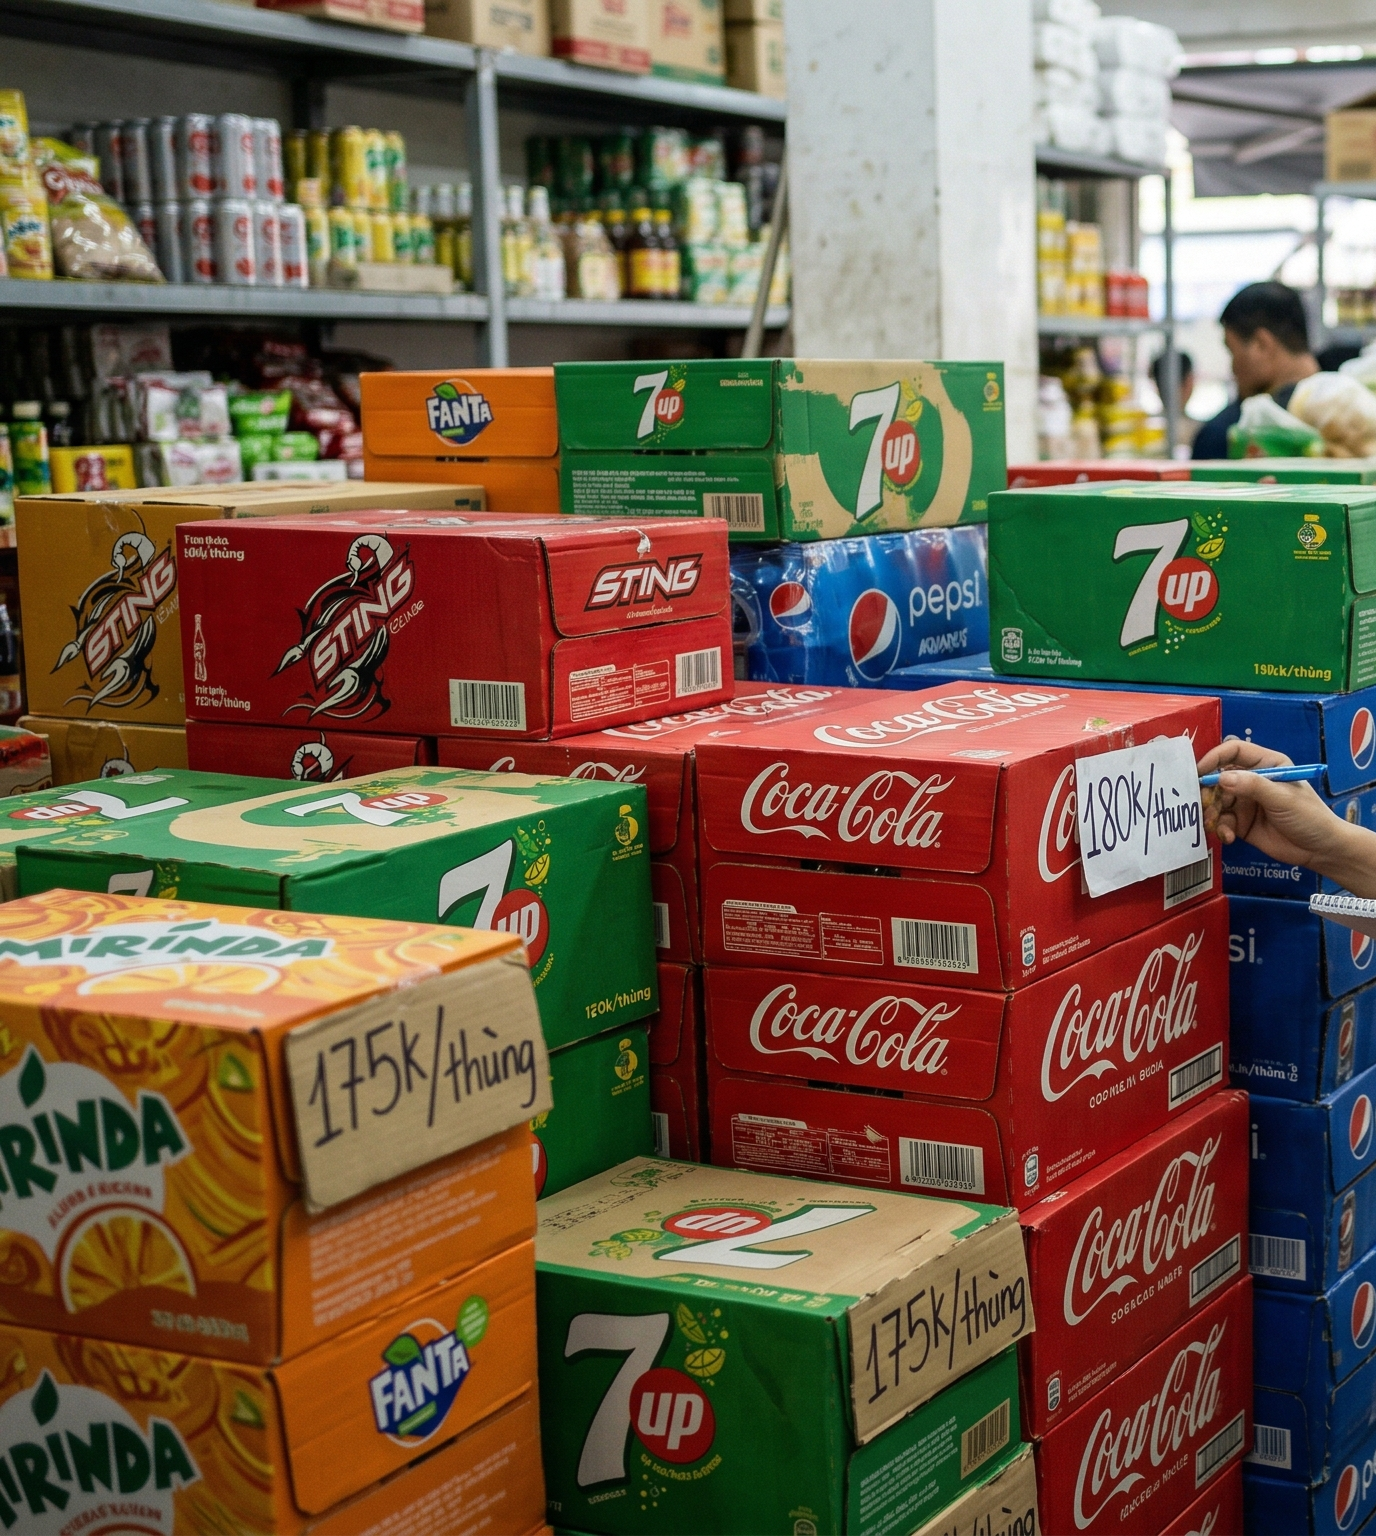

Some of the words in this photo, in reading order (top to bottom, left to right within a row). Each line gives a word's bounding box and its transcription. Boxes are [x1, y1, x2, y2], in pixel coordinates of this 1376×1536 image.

[86, 555, 176, 674] STING
[313, 560, 413, 681] STING
[591, 560, 698, 604] STING
[908, 570, 981, 627] pepsi
[813, 687, 1062, 749] Coca-Cola
[740, 761, 957, 850] Coca-Cola
[749, 983, 963, 1076] Coca-Cola
[1040, 928, 1205, 1103] Coca-Cola
[0, 1094, 188, 1200] RINDA
[1063, 1130, 1223, 1327] Coca-Cola
[1073, 1315, 1229, 1531] Coca-Cola
